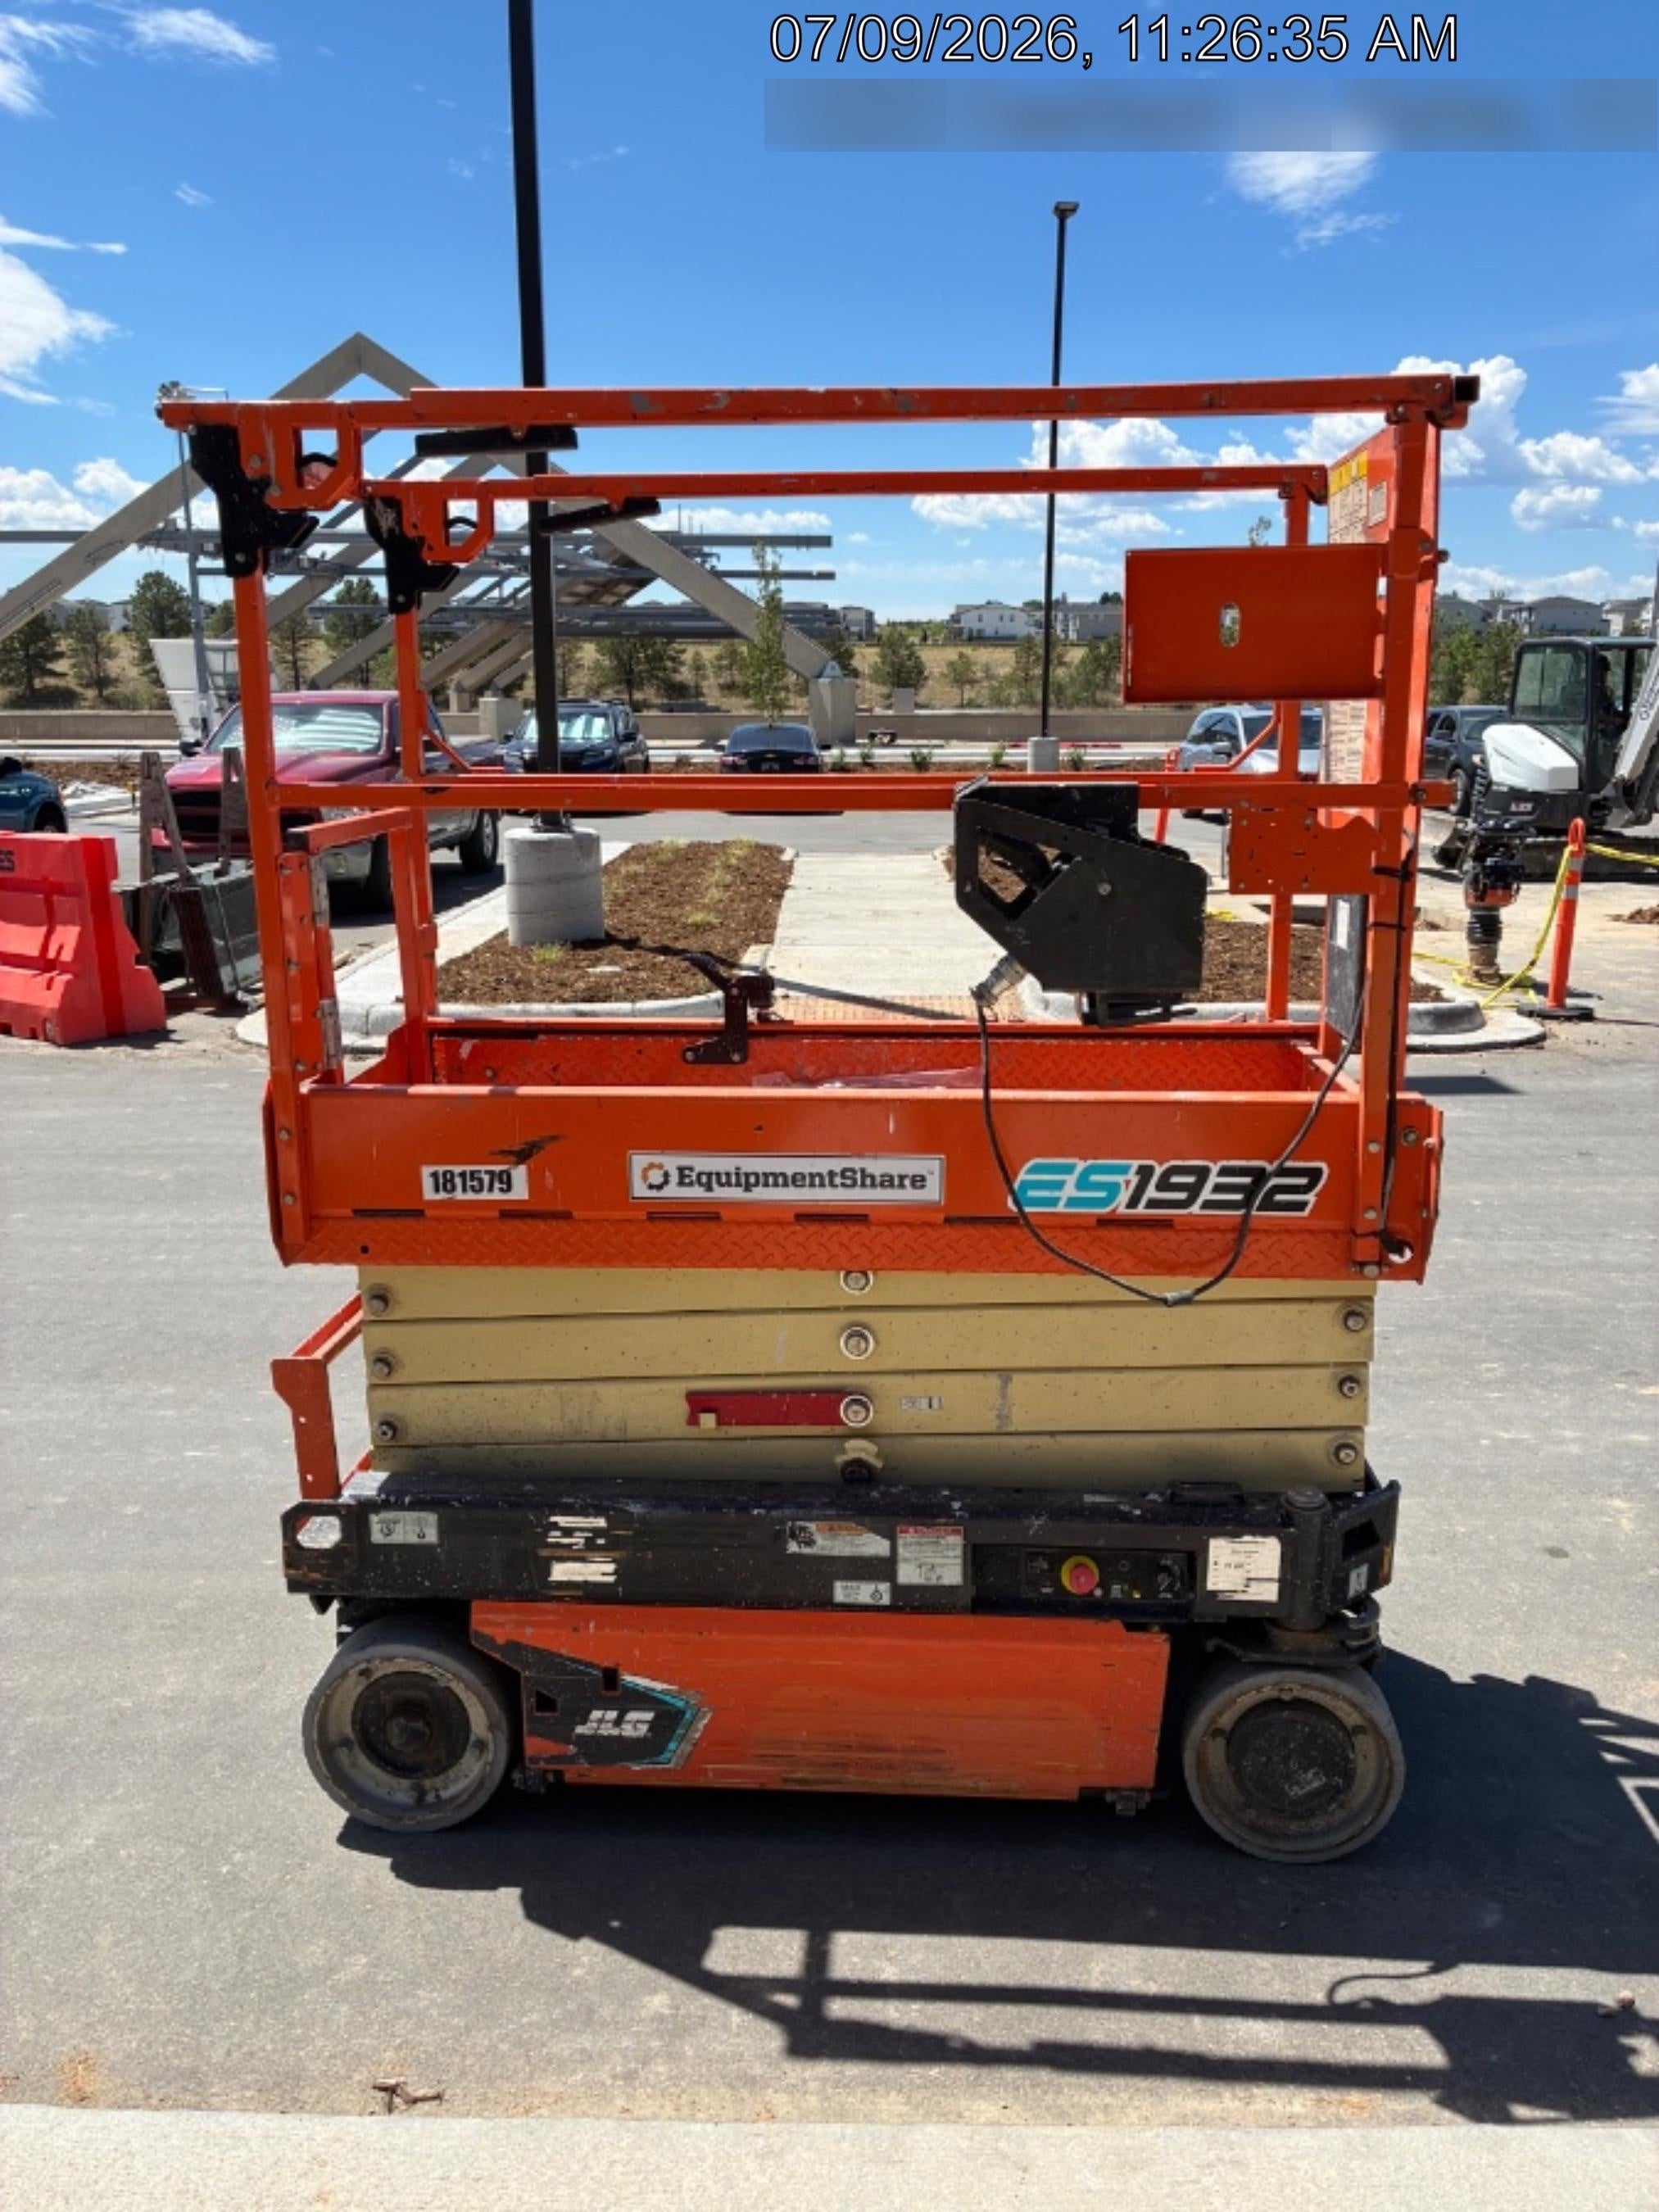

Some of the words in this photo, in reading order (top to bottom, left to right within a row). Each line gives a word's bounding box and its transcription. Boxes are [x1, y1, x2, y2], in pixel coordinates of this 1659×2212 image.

[428, 1168, 513, 1196] 181579
[676, 1165, 927, 1194] EquipmentShare
[1015, 1159, 1322, 1213] ES1932
[573, 1709, 655, 1738] JLG
